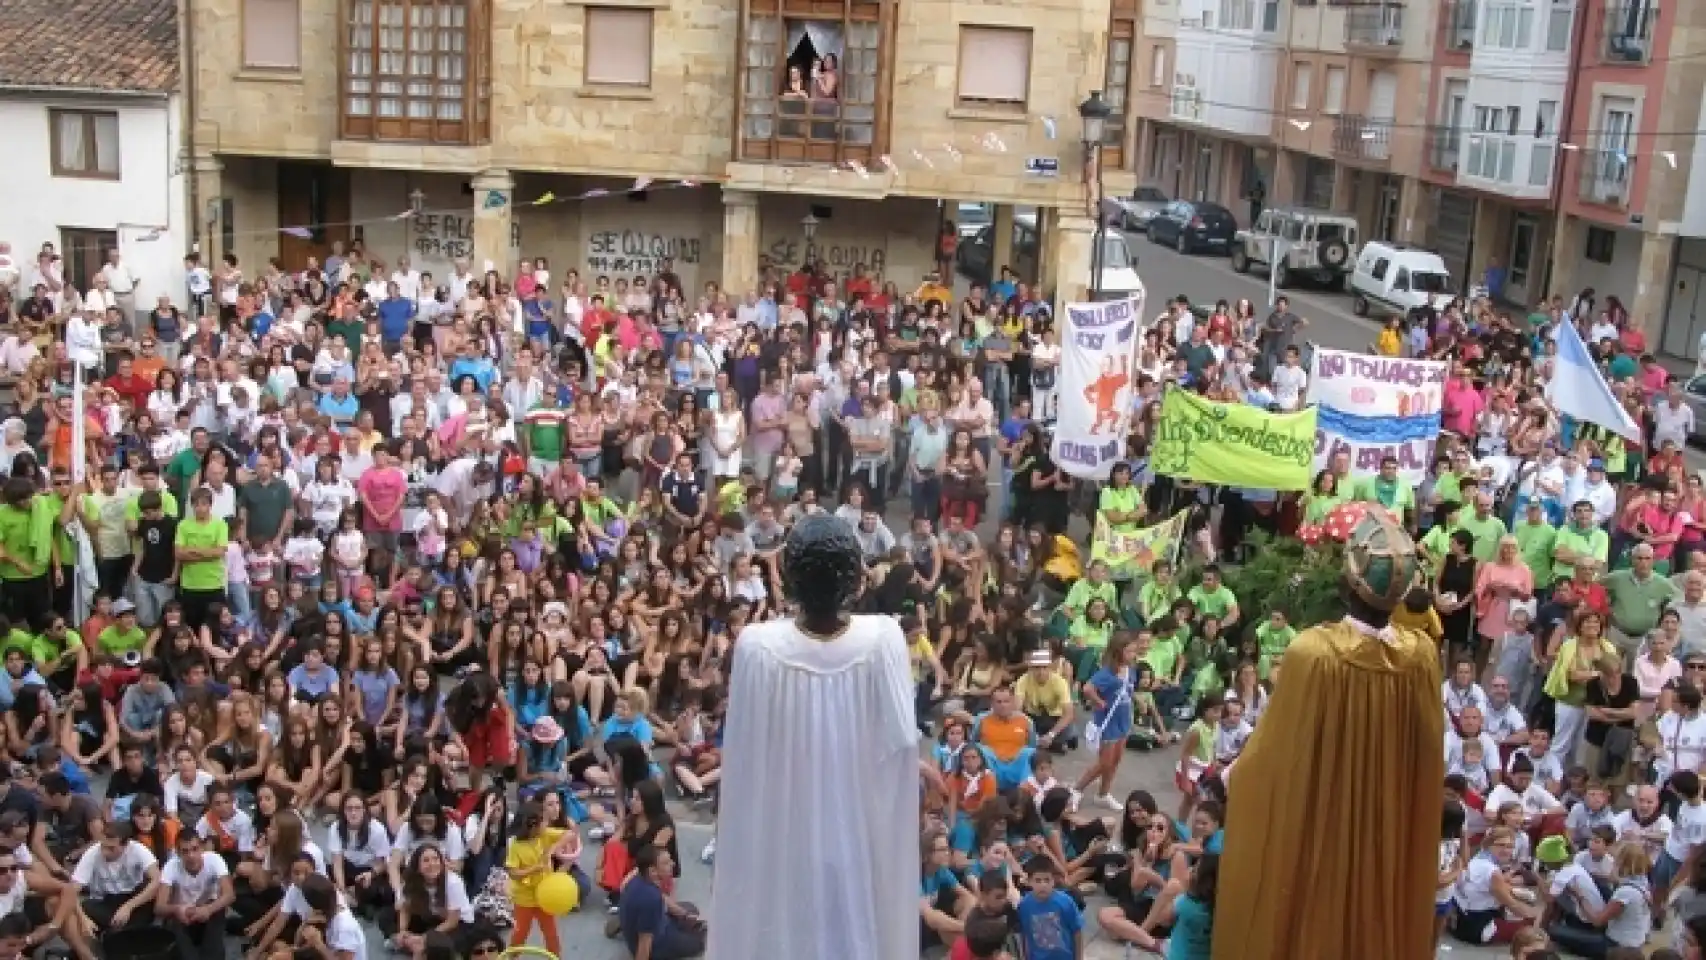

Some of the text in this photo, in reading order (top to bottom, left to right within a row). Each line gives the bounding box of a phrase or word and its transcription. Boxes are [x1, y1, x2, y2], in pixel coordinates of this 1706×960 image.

[413, 213, 439, 235] SE
[590, 231, 618, 254] SE
[770, 237, 799, 266] SE
